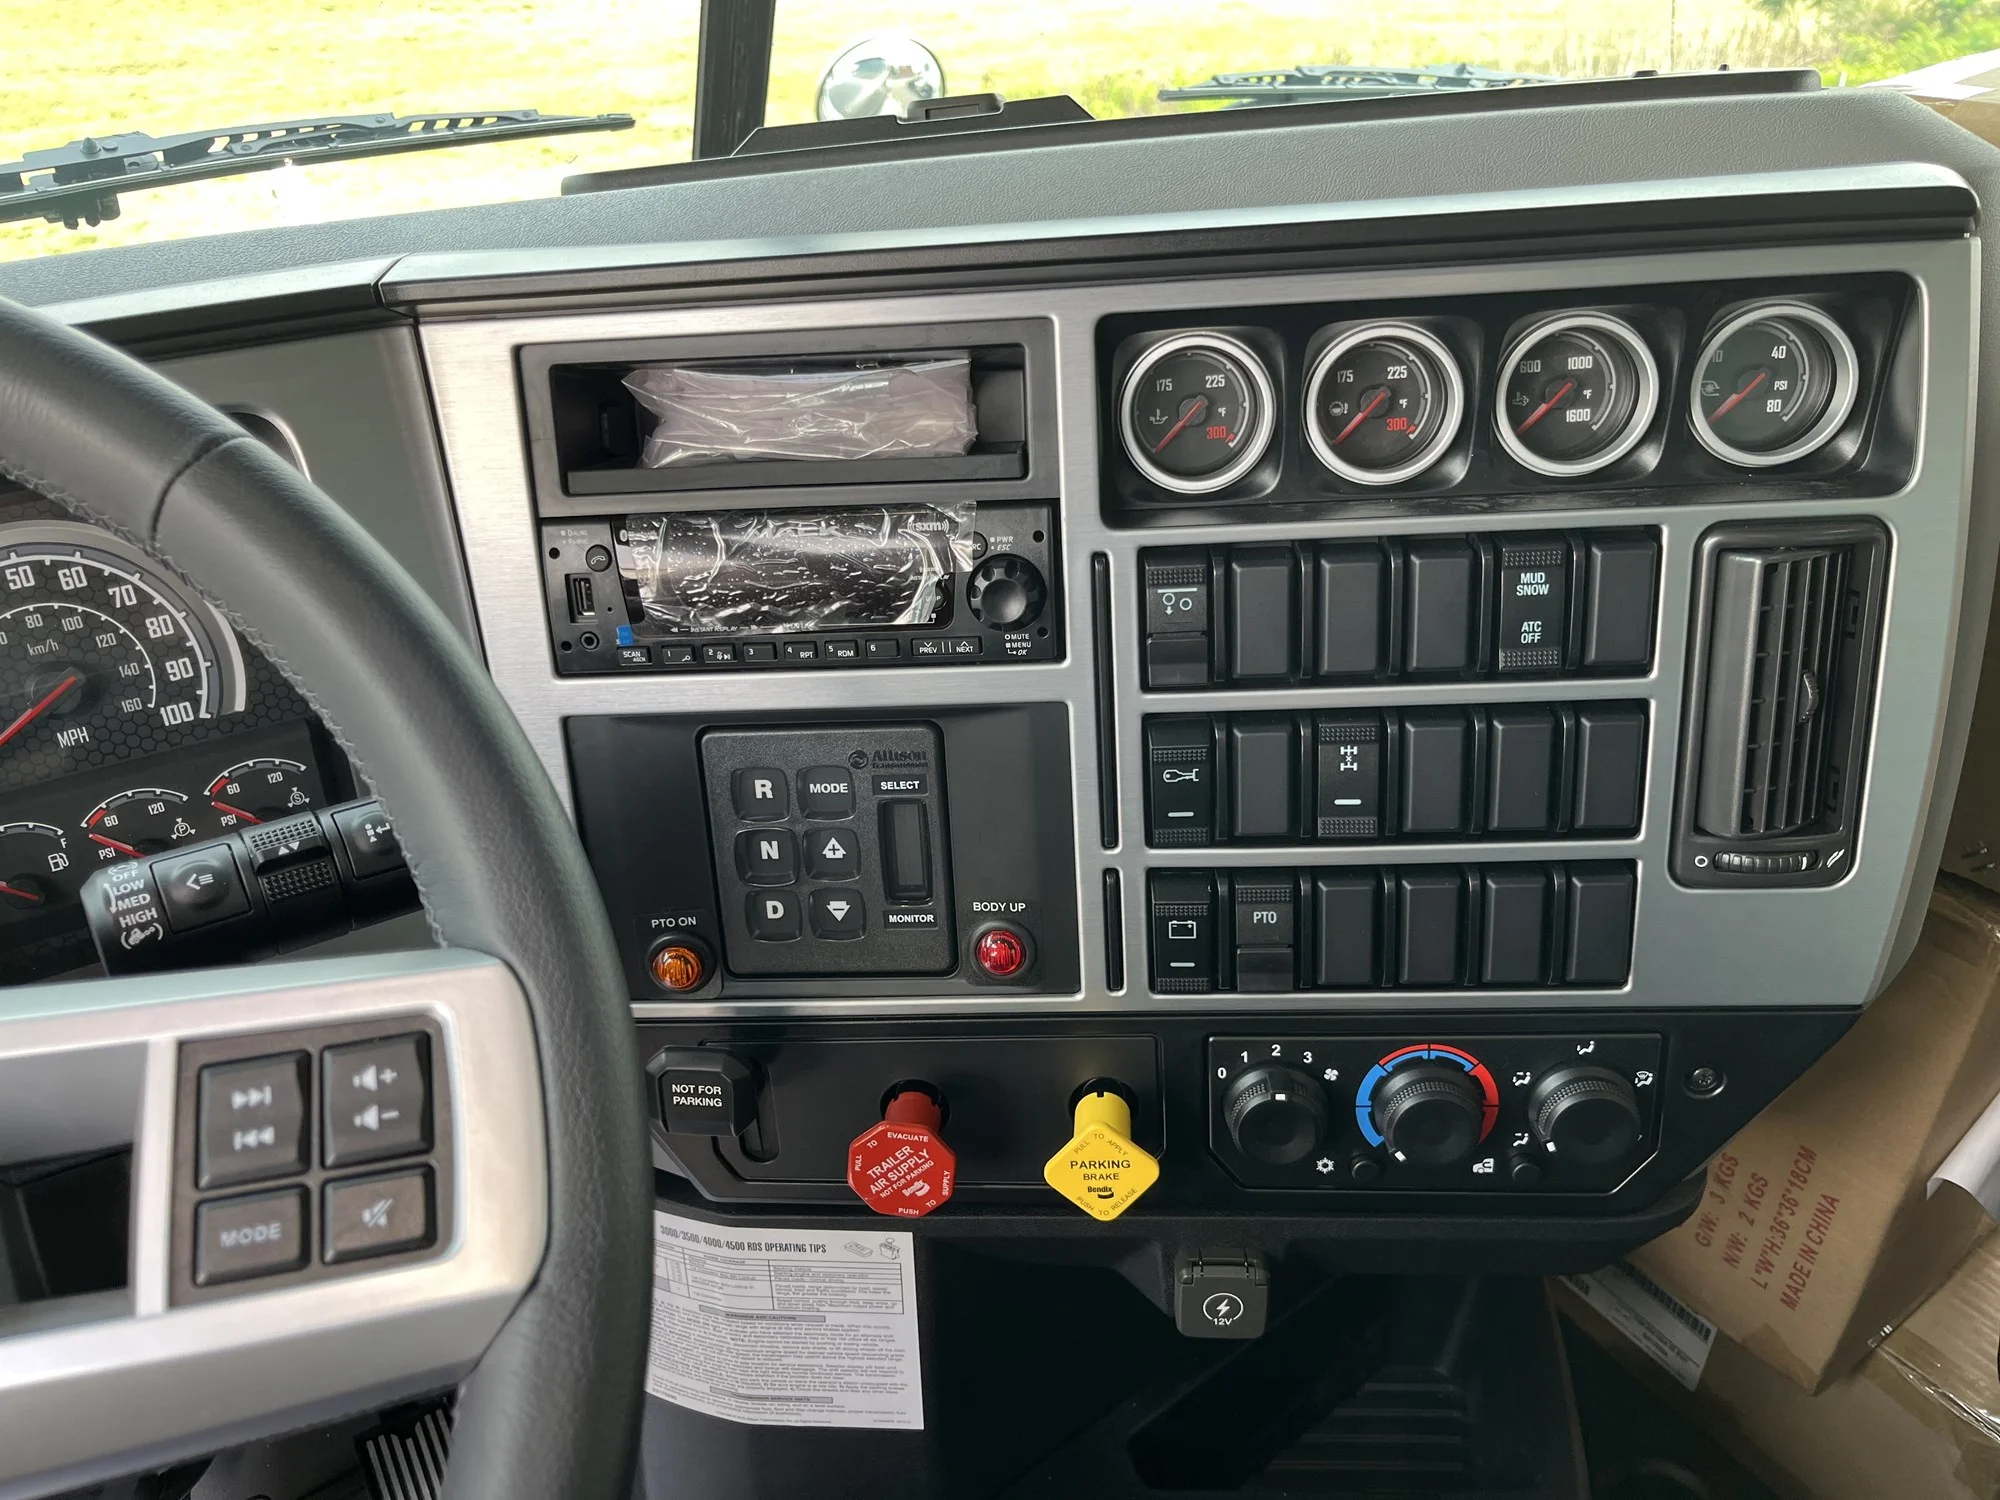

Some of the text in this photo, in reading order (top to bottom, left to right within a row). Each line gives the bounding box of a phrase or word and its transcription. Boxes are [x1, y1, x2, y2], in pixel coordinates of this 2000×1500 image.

[1771, 345, 1787, 360] 40
[1520, 359, 1541, 374] 600
[1567, 355, 1593, 371] 1000
[1337, 369, 1354, 383] 175
[1387, 365, 1408, 380] 225
[1156, 378, 1173, 392] 175
[1205, 374, 1226, 389] 225
[1773, 380, 1788, 391] PSI
[1766, 399, 1782, 413] 80
[1565, 408, 1591, 423] 1600
[1386, 417, 1408, 432] 300
[1206, 426, 1227, 440] 300
[5, 565, 36, 590] 50
[57, 566, 88, 591] 60
[1520, 572, 1546, 584] MUD
[108, 584, 137, 608] 70
[1516, 584, 1549, 596] SNOW
[25, 613, 43, 629] 80
[61, 615, 84, 632] 100
[145, 615, 175, 638] 80
[1521, 621, 1542, 632] ATC
[95, 632, 117, 649] 120
[1520, 633, 1542, 644] OFF
[27, 639, 59, 656] km/h
[749, 648, 754, 656] 3
[119, 662, 140, 678] 140
[165, 657, 194, 682] 90
[121, 697, 143, 713] 160
[160, 701, 195, 726] 100
[57, 726, 90, 749] MPH
[267, 772, 284, 784] 120
[880, 781, 920, 790] SELECT
[226, 783, 241, 795] 60
[755, 779, 773, 799] R
[809, 783, 849, 794] MODE
[148, 802, 166, 815] 120
[104, 815, 119, 828] 60
[220, 814, 238, 827] PSI
[60, 838, 68, 849] F
[760, 841, 779, 860] N
[99, 847, 116, 861] PSI
[111, 869, 138, 882] OFF
[113, 879, 145, 896] LOW
[117, 893, 151, 911] MED
[973, 901, 1026, 913] BODY UP
[119, 907, 159, 928] HIGH
[766, 901, 785, 919] D
[1252, 910, 1277, 925] PTO
[651, 916, 697, 929] PTO ON
[888, 914, 935, 924] MONITOR
[1240, 1051, 1249, 1063] 1
[1271, 1044, 1281, 1056] 2
[1303, 1051, 1313, 1064] 3
[1217, 1067, 1227, 1079] 0
[671, 1084, 722, 1096] NOT FOR
[672, 1096, 723, 1108] PARKING
[867, 1140, 878, 1149] TO
[887, 1132, 929, 1142] EVACUATE
[1073, 1140, 1090, 1155] PULL
[1107, 1139, 1129, 1156] APPLY
[867, 1145, 915, 1179] TRAILER
[1070, 1160, 1131, 1169] PARKING
[869, 1148, 930, 1195] AIR SUPPLY
[1083, 1173, 1120, 1181] BRAKE
[1713, 1151, 1739, 1190] KGS
[880, 1160, 935, 1199] NOT FOR PARKING
[898, 1170, 951, 1215] PUSH TO SUPPLY
[1076, 1196, 1095, 1211] PUSH
[1110, 1187, 1138, 1211] RELEASE
[1709, 1190, 1725, 1205] 3
[1744, 1172, 1769, 1211] KGS
[1738, 1210, 1755, 1228] 2
[220, 1222, 282, 1248] MODE
[747, 1242, 763, 1252] RDS
[764, 1242, 807, 1253] OPERATING
[809, 1244, 827, 1253] TIPS
[1779, 1193, 1841, 1312] MADE IN CHINA
[1213, 1317, 1232, 1325] 12V
